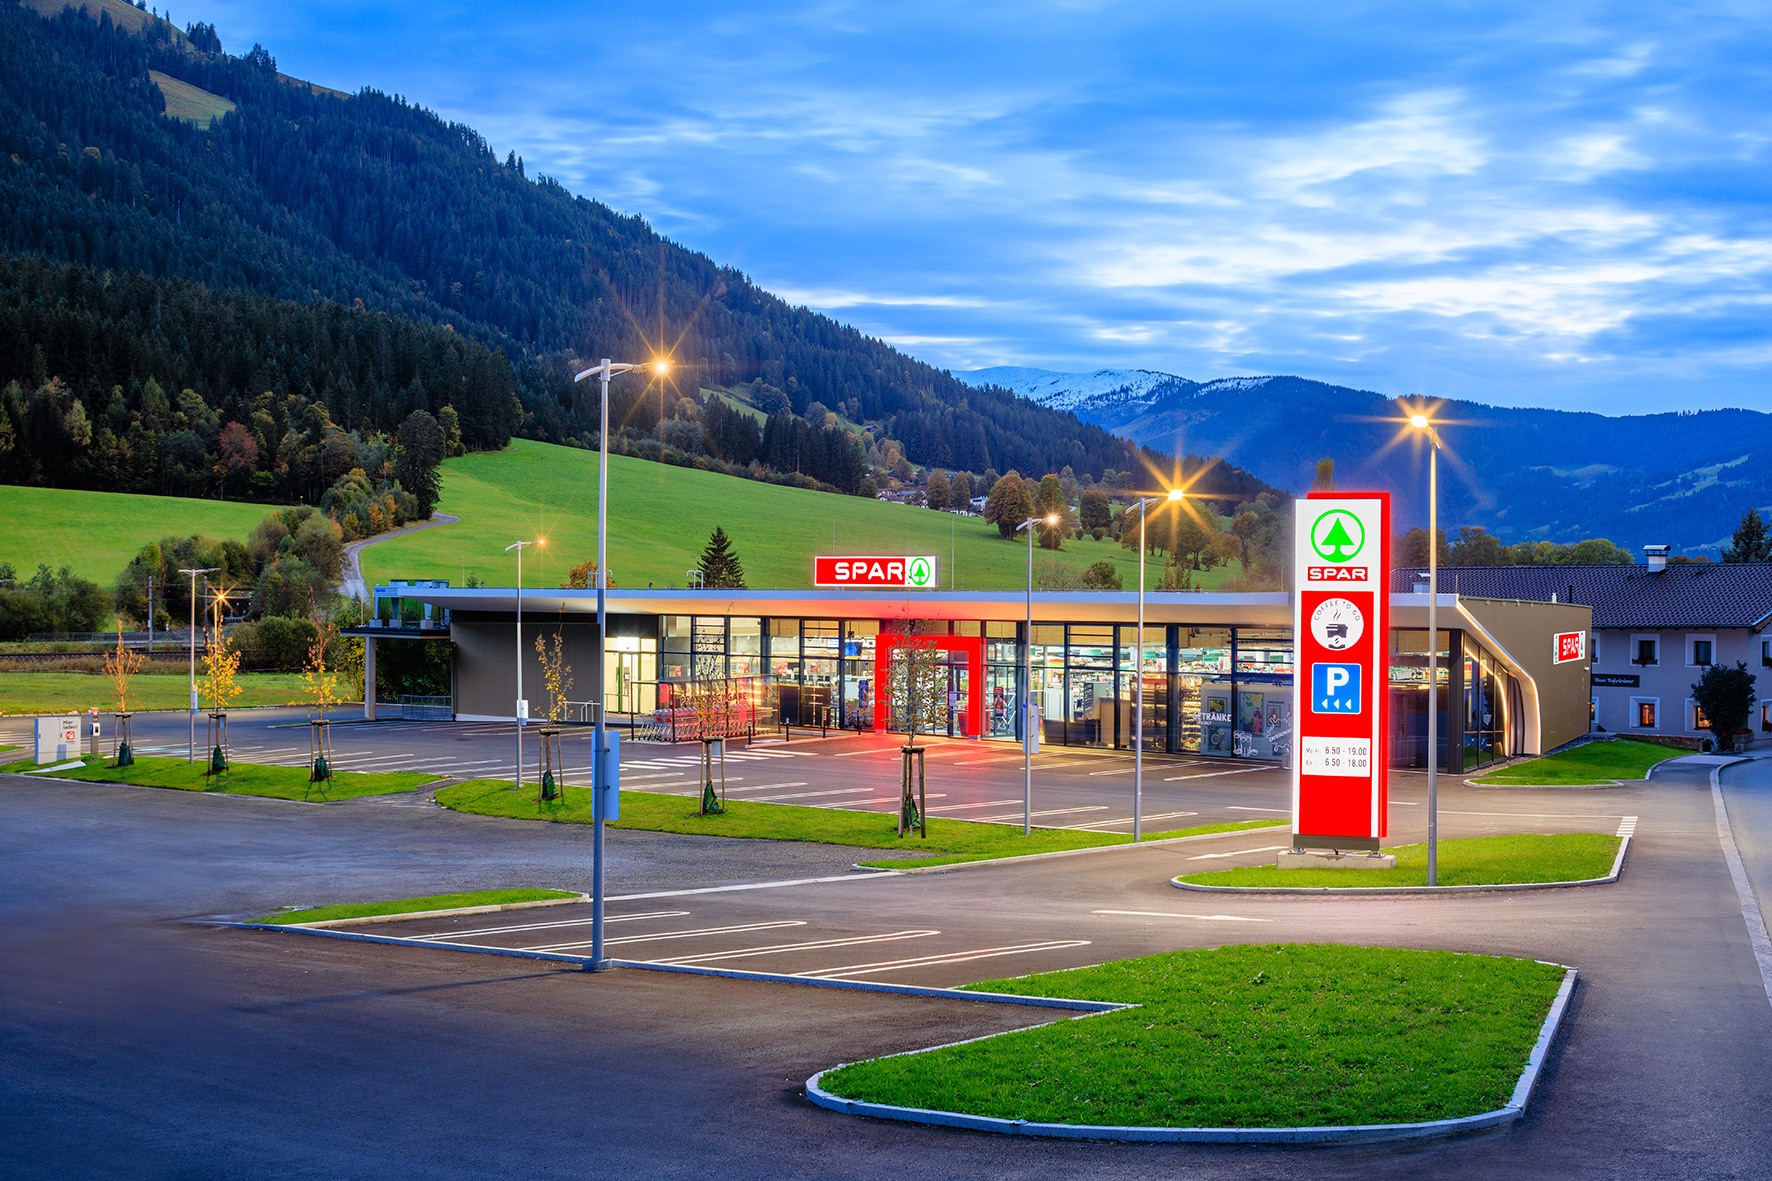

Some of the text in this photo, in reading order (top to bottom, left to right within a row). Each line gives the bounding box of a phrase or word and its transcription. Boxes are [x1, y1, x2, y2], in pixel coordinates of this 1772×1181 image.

[834, 561, 904, 581] SPAR
[1309, 568, 1366, 580] SPAR
[1313, 599, 1361, 622] COFFEE TO GO
[1563, 636, 1580, 656] SPAR
[1326, 666, 1350, 696] P
[1192, 711, 1232, 723] GETRÄNKE
[1324, 746, 1341, 755] 6.50
[1348, 747, 1367, 756] 19.00
[1324, 758, 1341, 767] 6.50
[1348, 758, 1367, 768] 18.00
